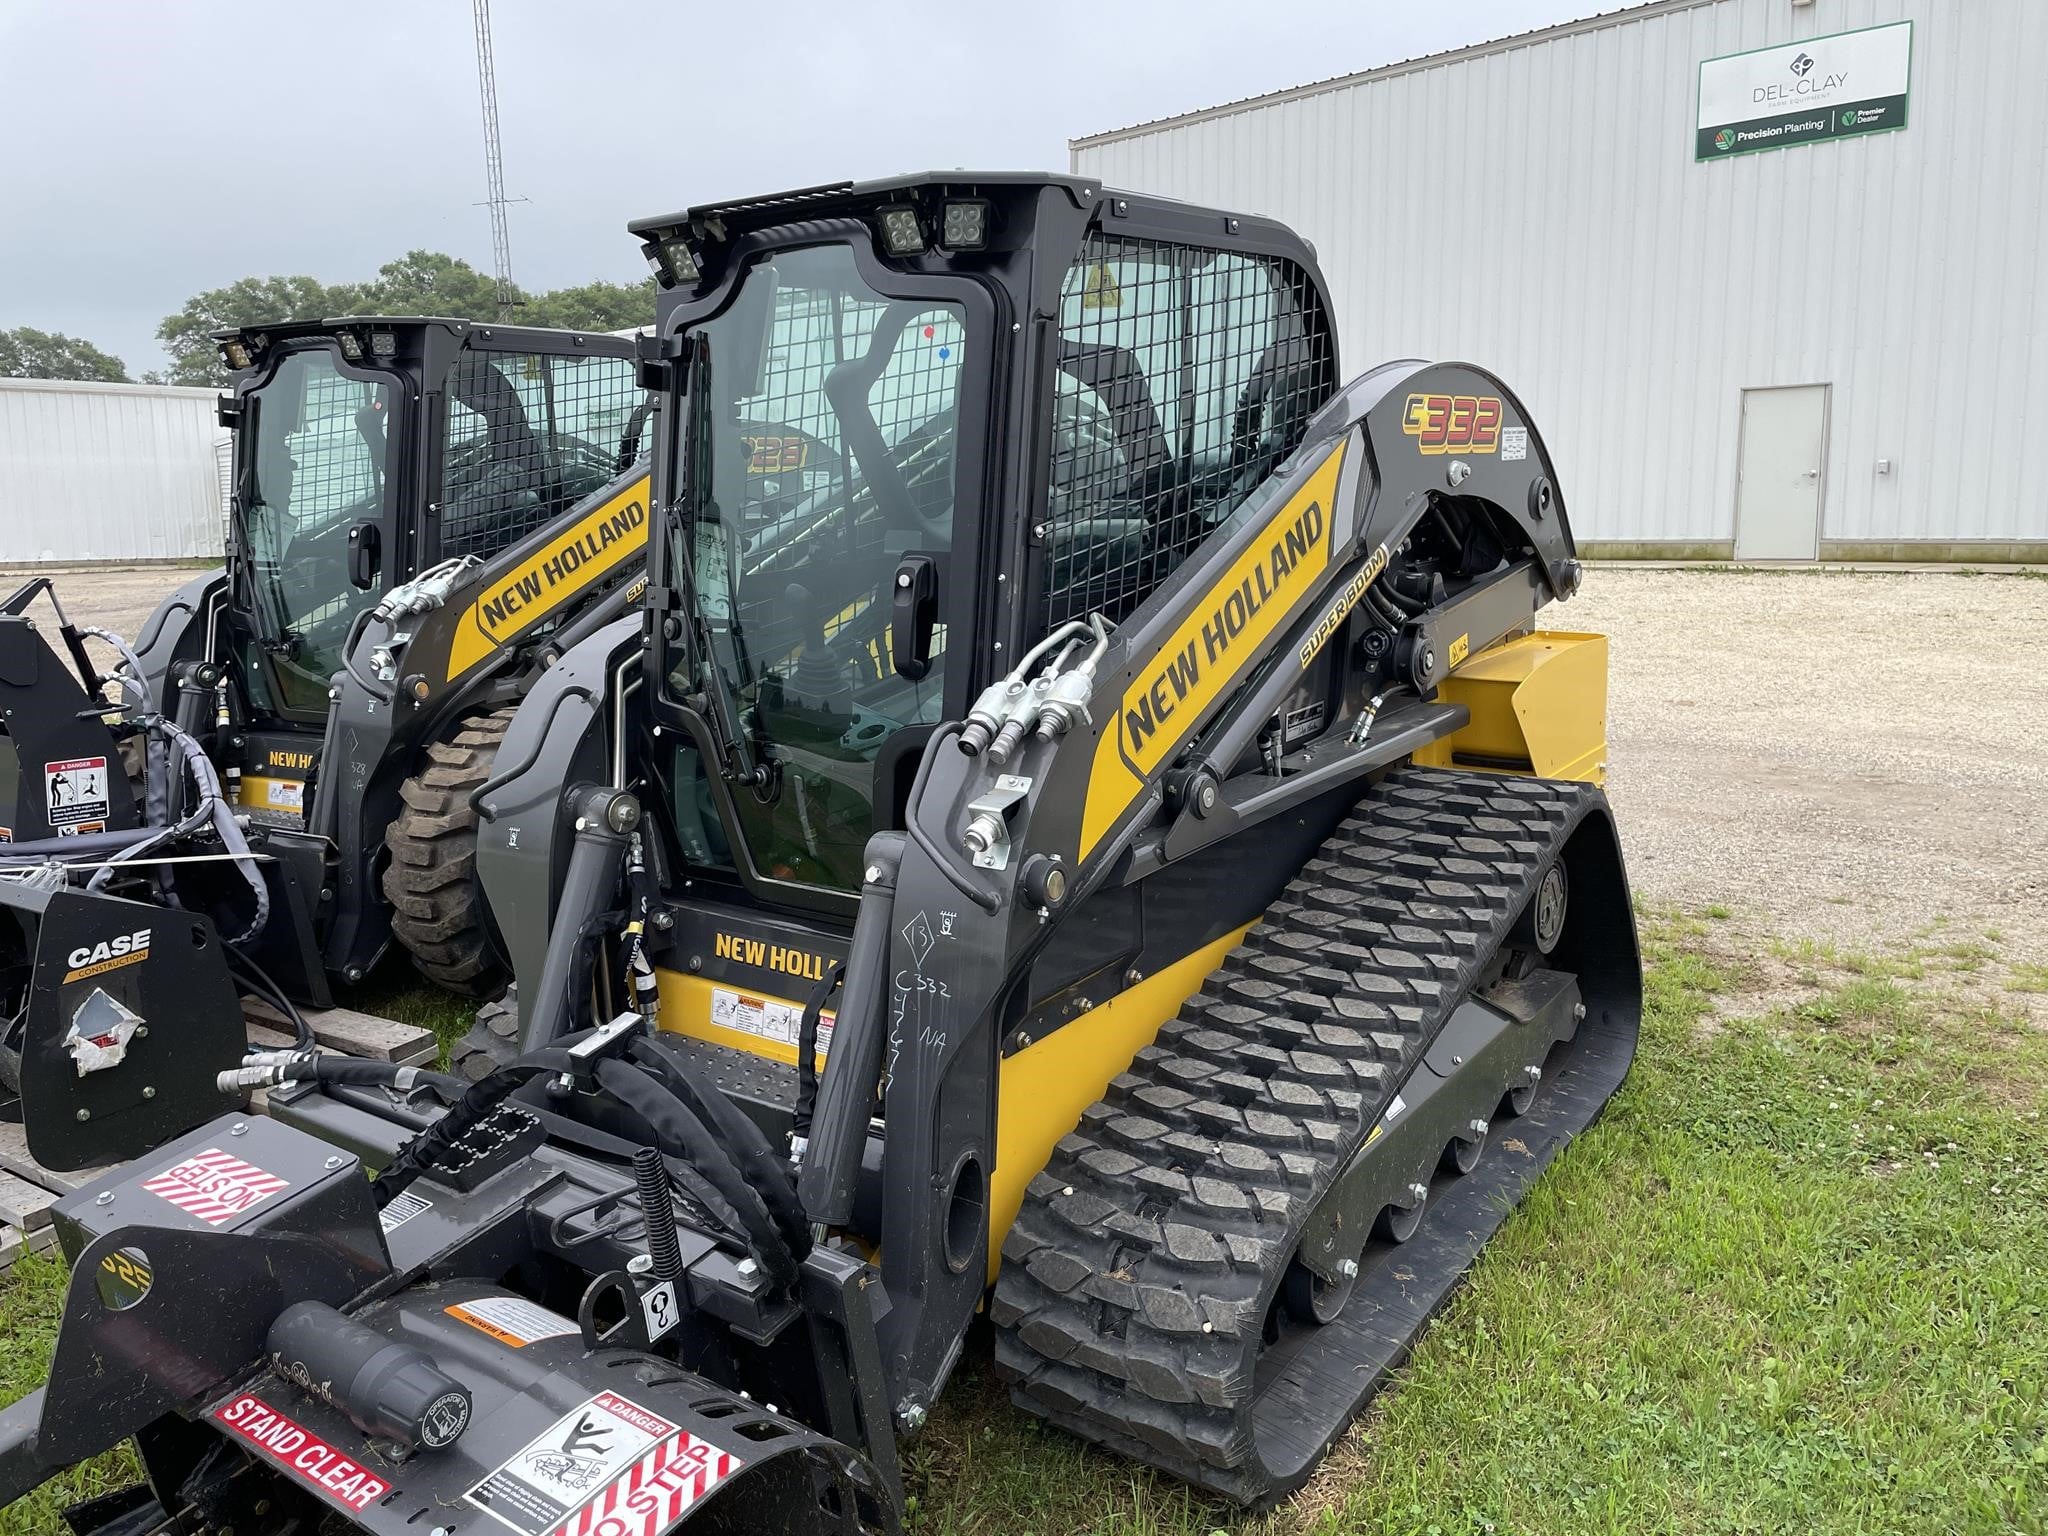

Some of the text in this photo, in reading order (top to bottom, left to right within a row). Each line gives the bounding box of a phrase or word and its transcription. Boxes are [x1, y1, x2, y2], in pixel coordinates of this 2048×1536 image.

[1753, 71, 1848, 102] DEL-CLAY
[1768, 93, 1830, 108] FARM EQUIPMENT
[1857, 107, 1886, 117] Premier
[1857, 114, 1879, 124] Dealer
[1737, 120, 1825, 142] Precision Planting
[481, 570, 543, 629] NEW
[544, 500, 645, 587] HOLLAND
[1124, 499, 1324, 754] NEW HOLLAND
[67, 761, 91, 769] DANGER
[269, 750, 297, 768] NEW
[67, 929, 152, 969] CASE
[715, 932, 766, 967] NEW
[911, 925, 928, 947] 13
[78, 950, 147, 979] CONSTRUCTION
[168, 1163, 263, 1210] NO STEP
[447, 1409, 466, 1438] MANUAL
[611, 1402, 667, 1438] DANGER
[223, 1398, 384, 1509] STAND CLEAR
[625, 1444, 711, 1514] STEP
